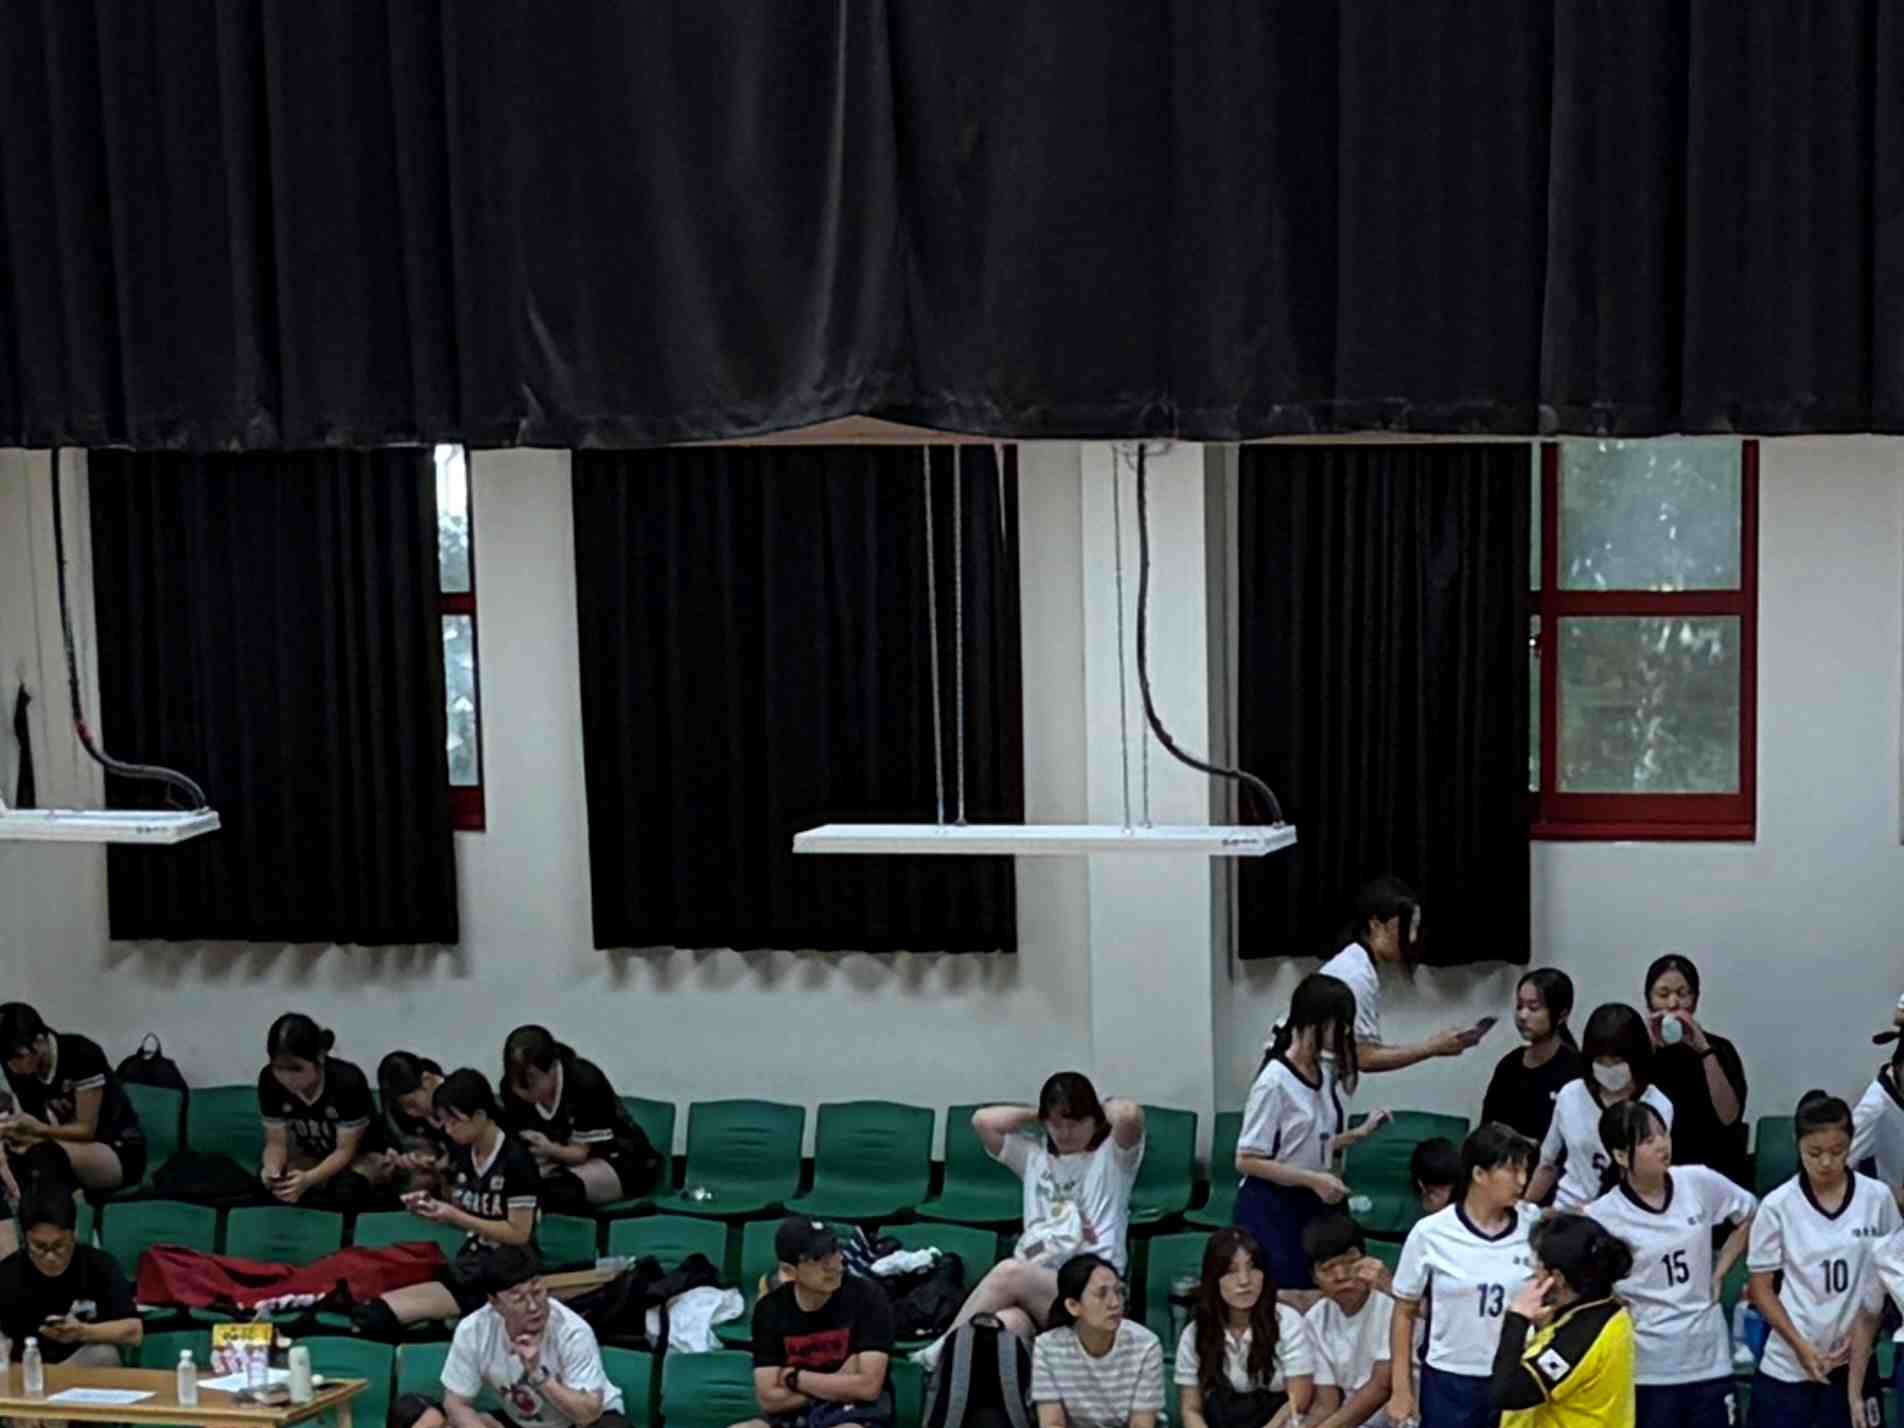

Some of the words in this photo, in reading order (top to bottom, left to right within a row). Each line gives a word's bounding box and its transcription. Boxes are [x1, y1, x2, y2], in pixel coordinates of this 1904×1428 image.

[1661, 1249, 1691, 1287] 15
[1819, 1258, 1849, 1294] 10
[1477, 1283, 1505, 1317] 13
